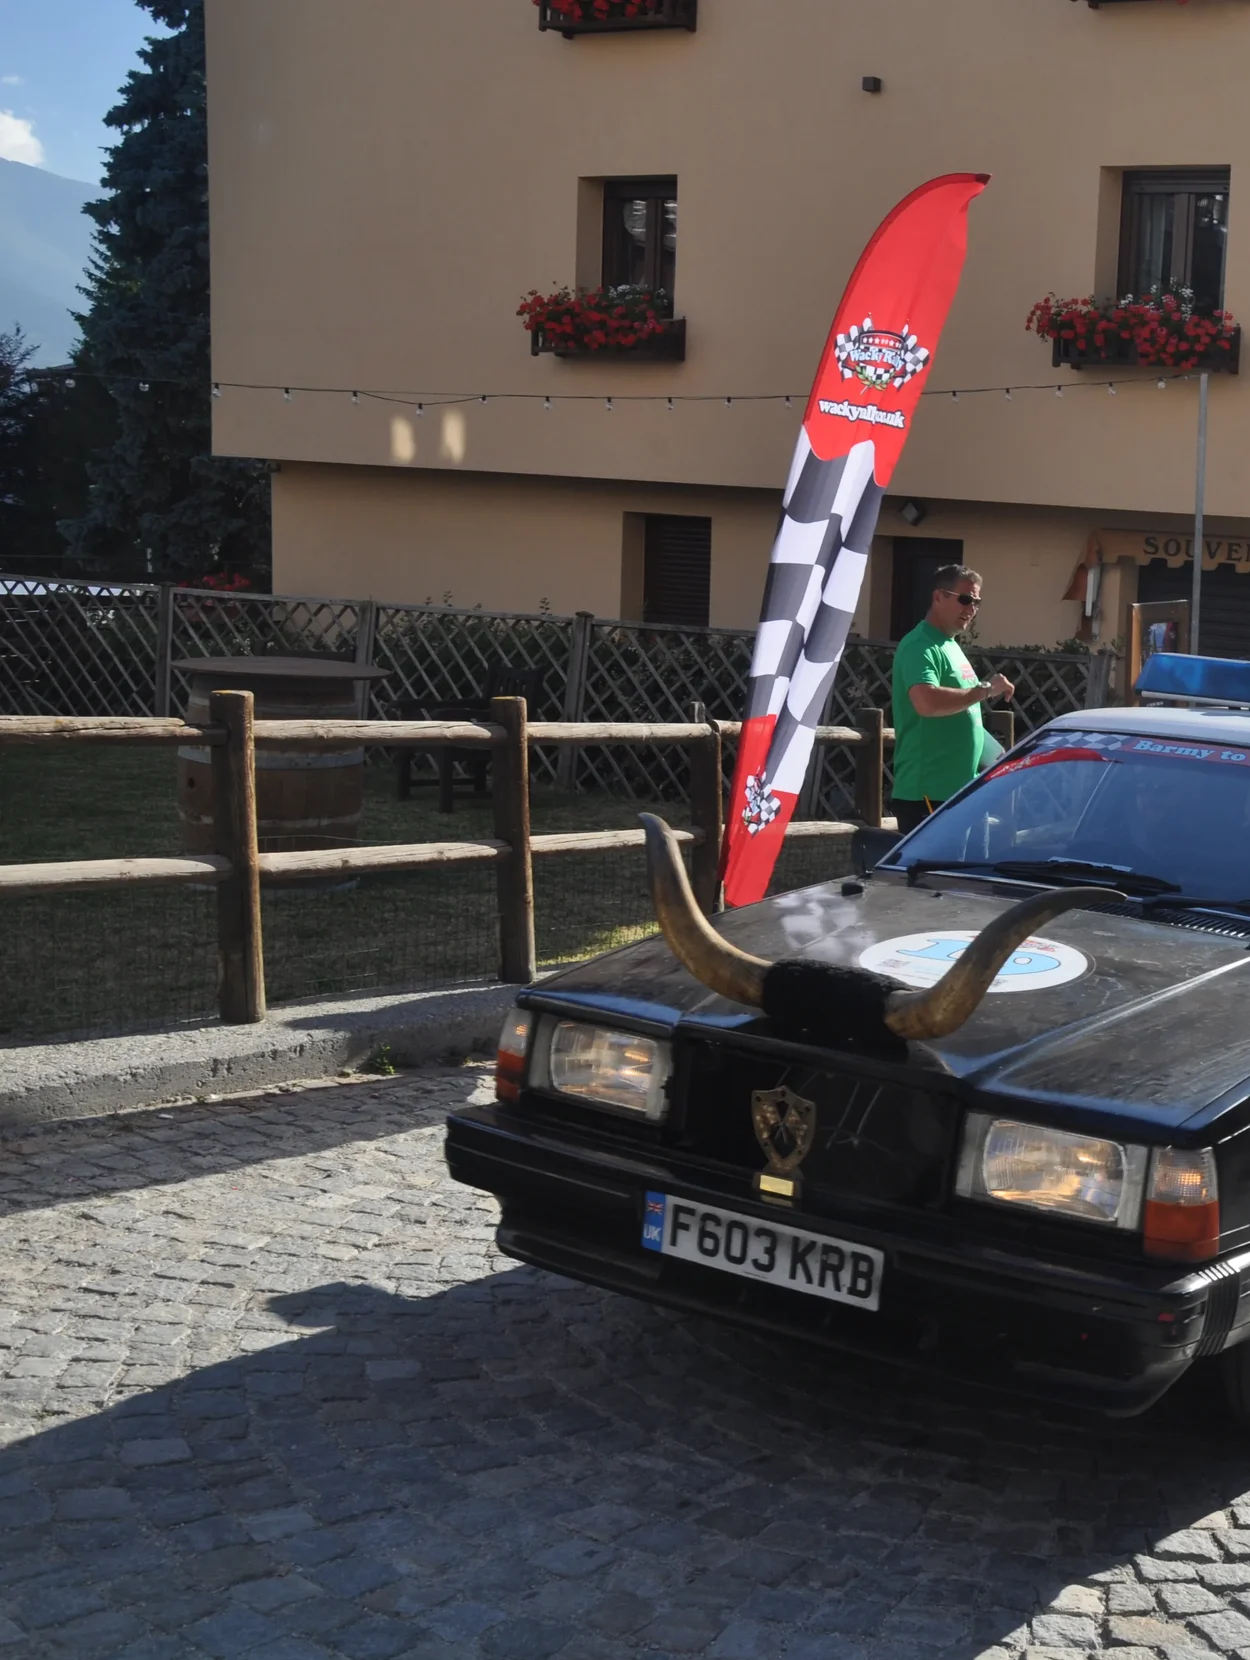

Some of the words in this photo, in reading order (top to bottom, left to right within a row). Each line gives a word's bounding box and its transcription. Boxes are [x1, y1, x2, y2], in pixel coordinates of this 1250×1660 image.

[1133, 739, 1215, 760] Barmy
[1220, 750, 1248, 762] to
[643, 1223, 662, 1242] UK
[669, 1203, 778, 1273] F603
[788, 1235, 876, 1299] KRB
